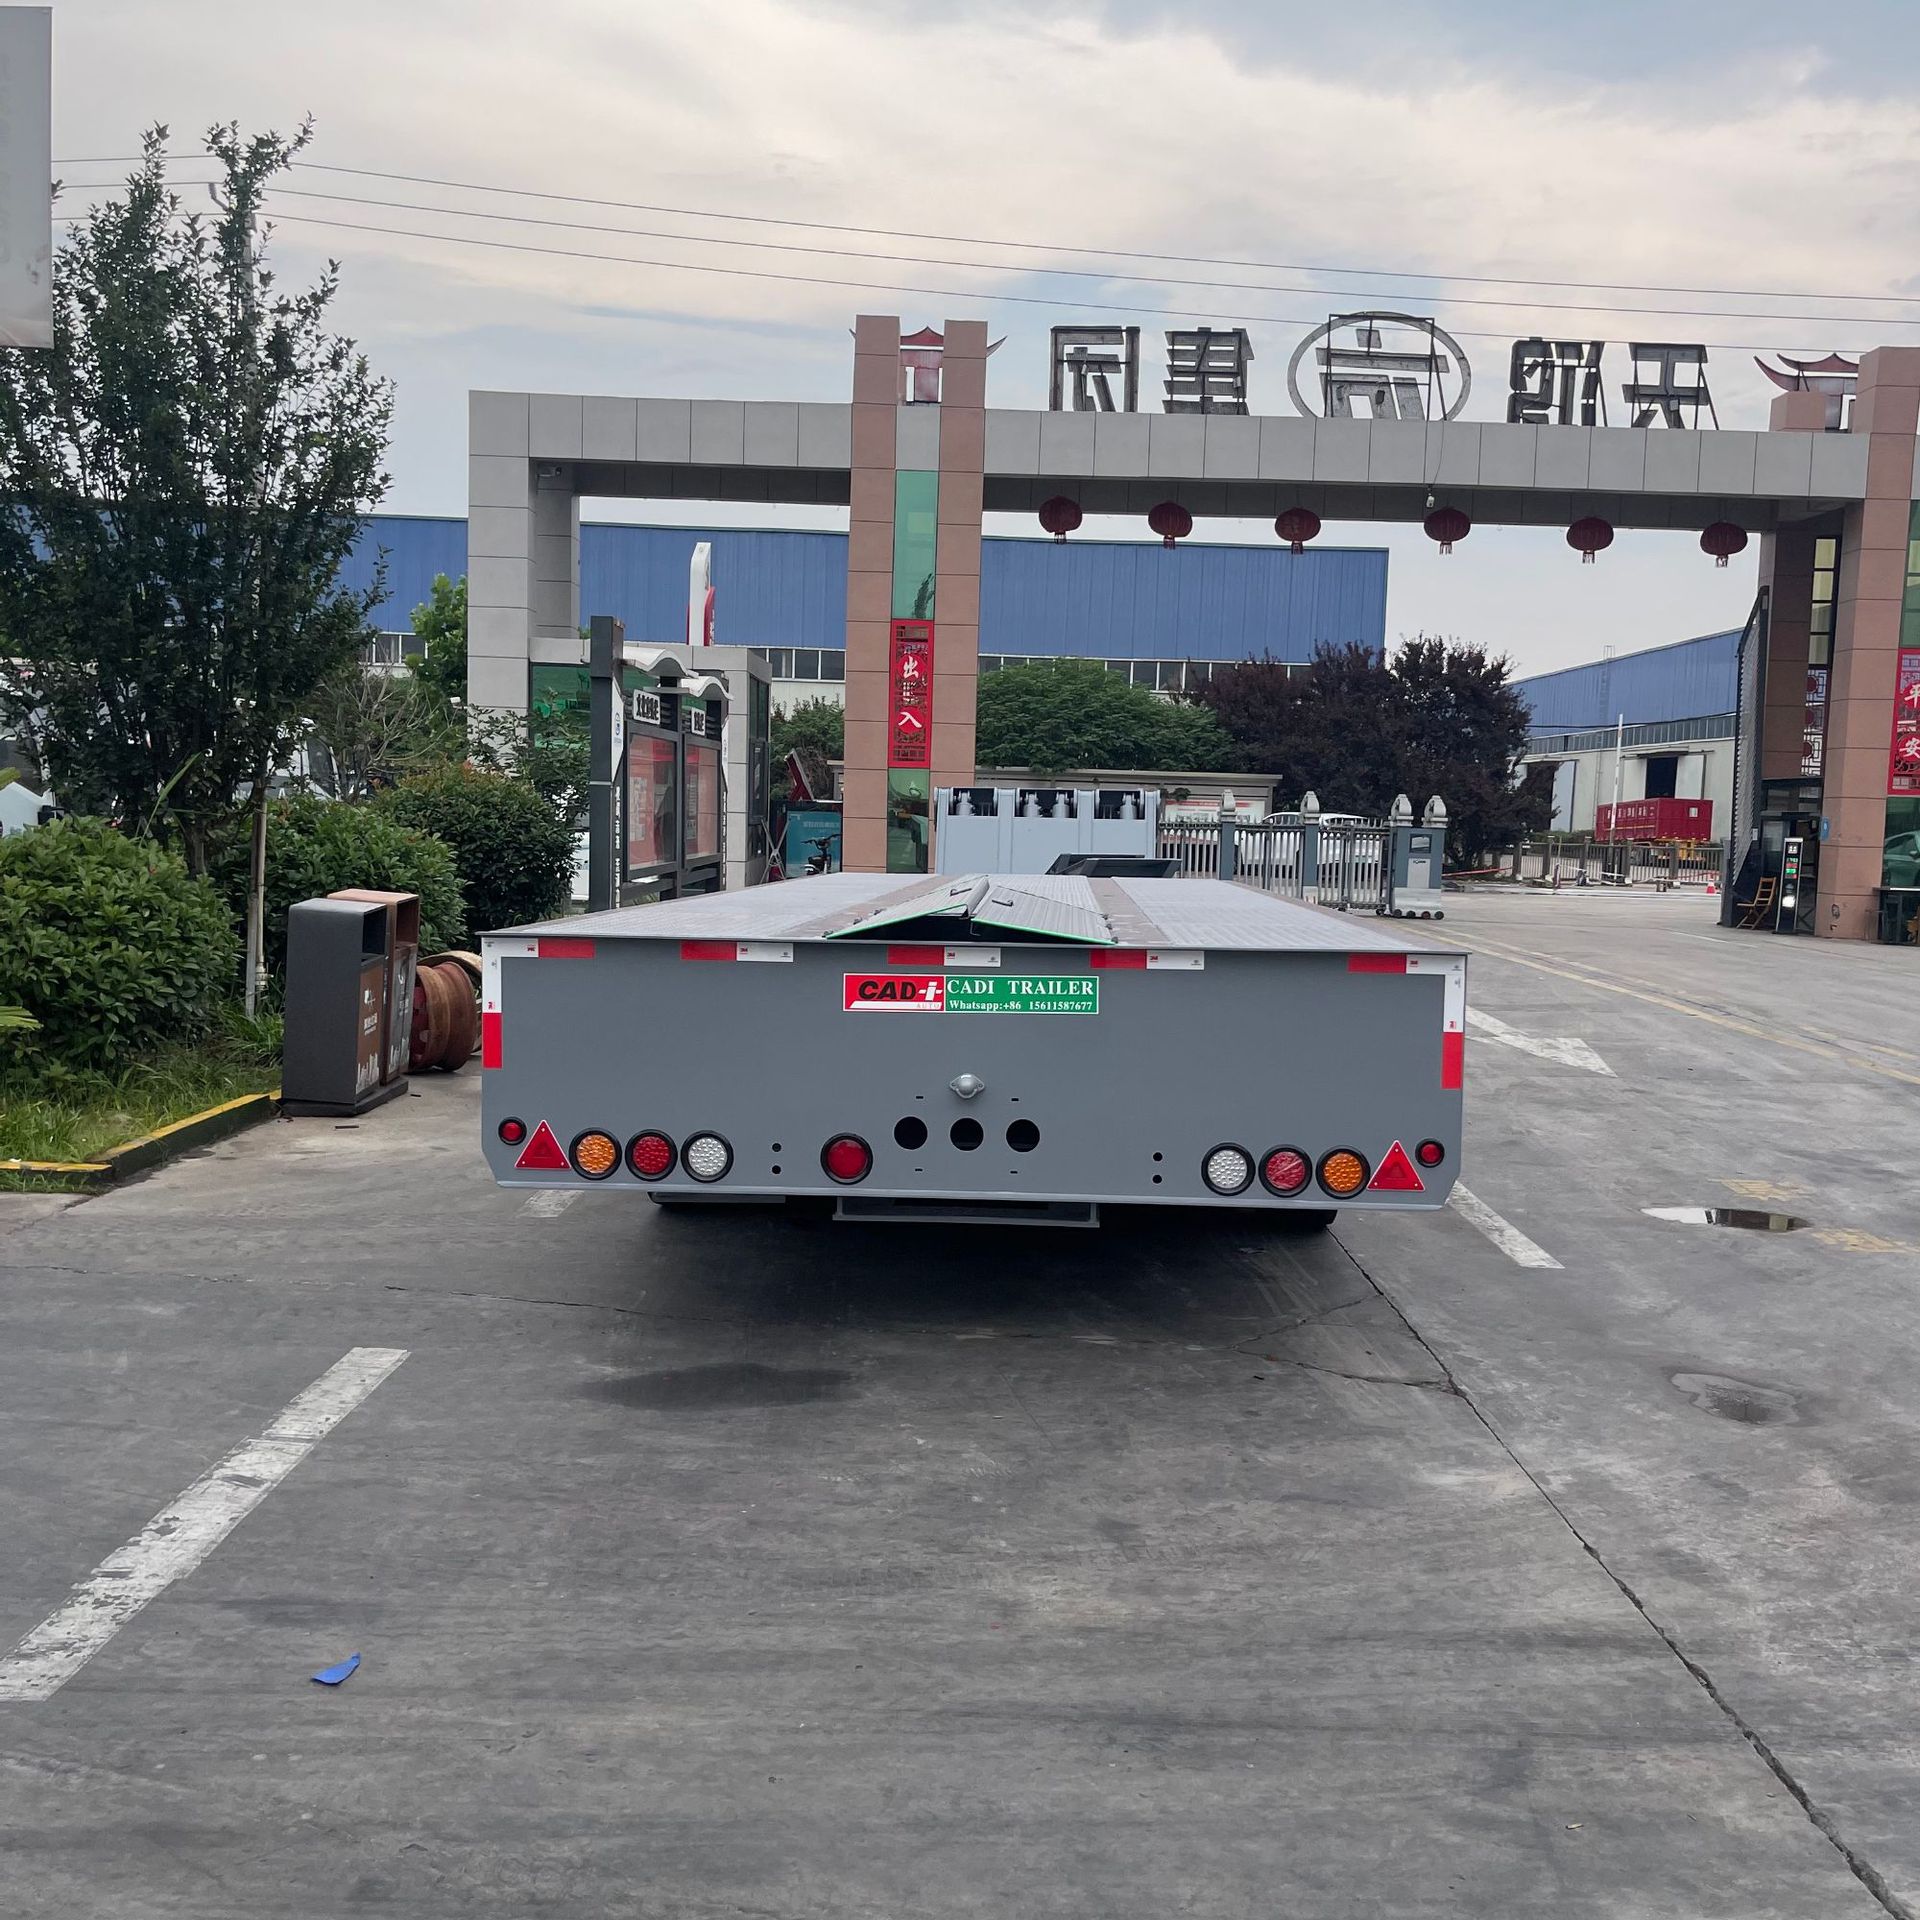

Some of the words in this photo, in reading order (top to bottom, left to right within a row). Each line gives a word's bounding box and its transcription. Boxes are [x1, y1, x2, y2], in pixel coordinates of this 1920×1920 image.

[947, 980, 995, 995] CADI
[1008, 980, 1094, 995] TRAILER
[949, 1000, 1021, 1011] Whatsapp:+86
[1029, 1001, 1093, 1010] 15611587677
